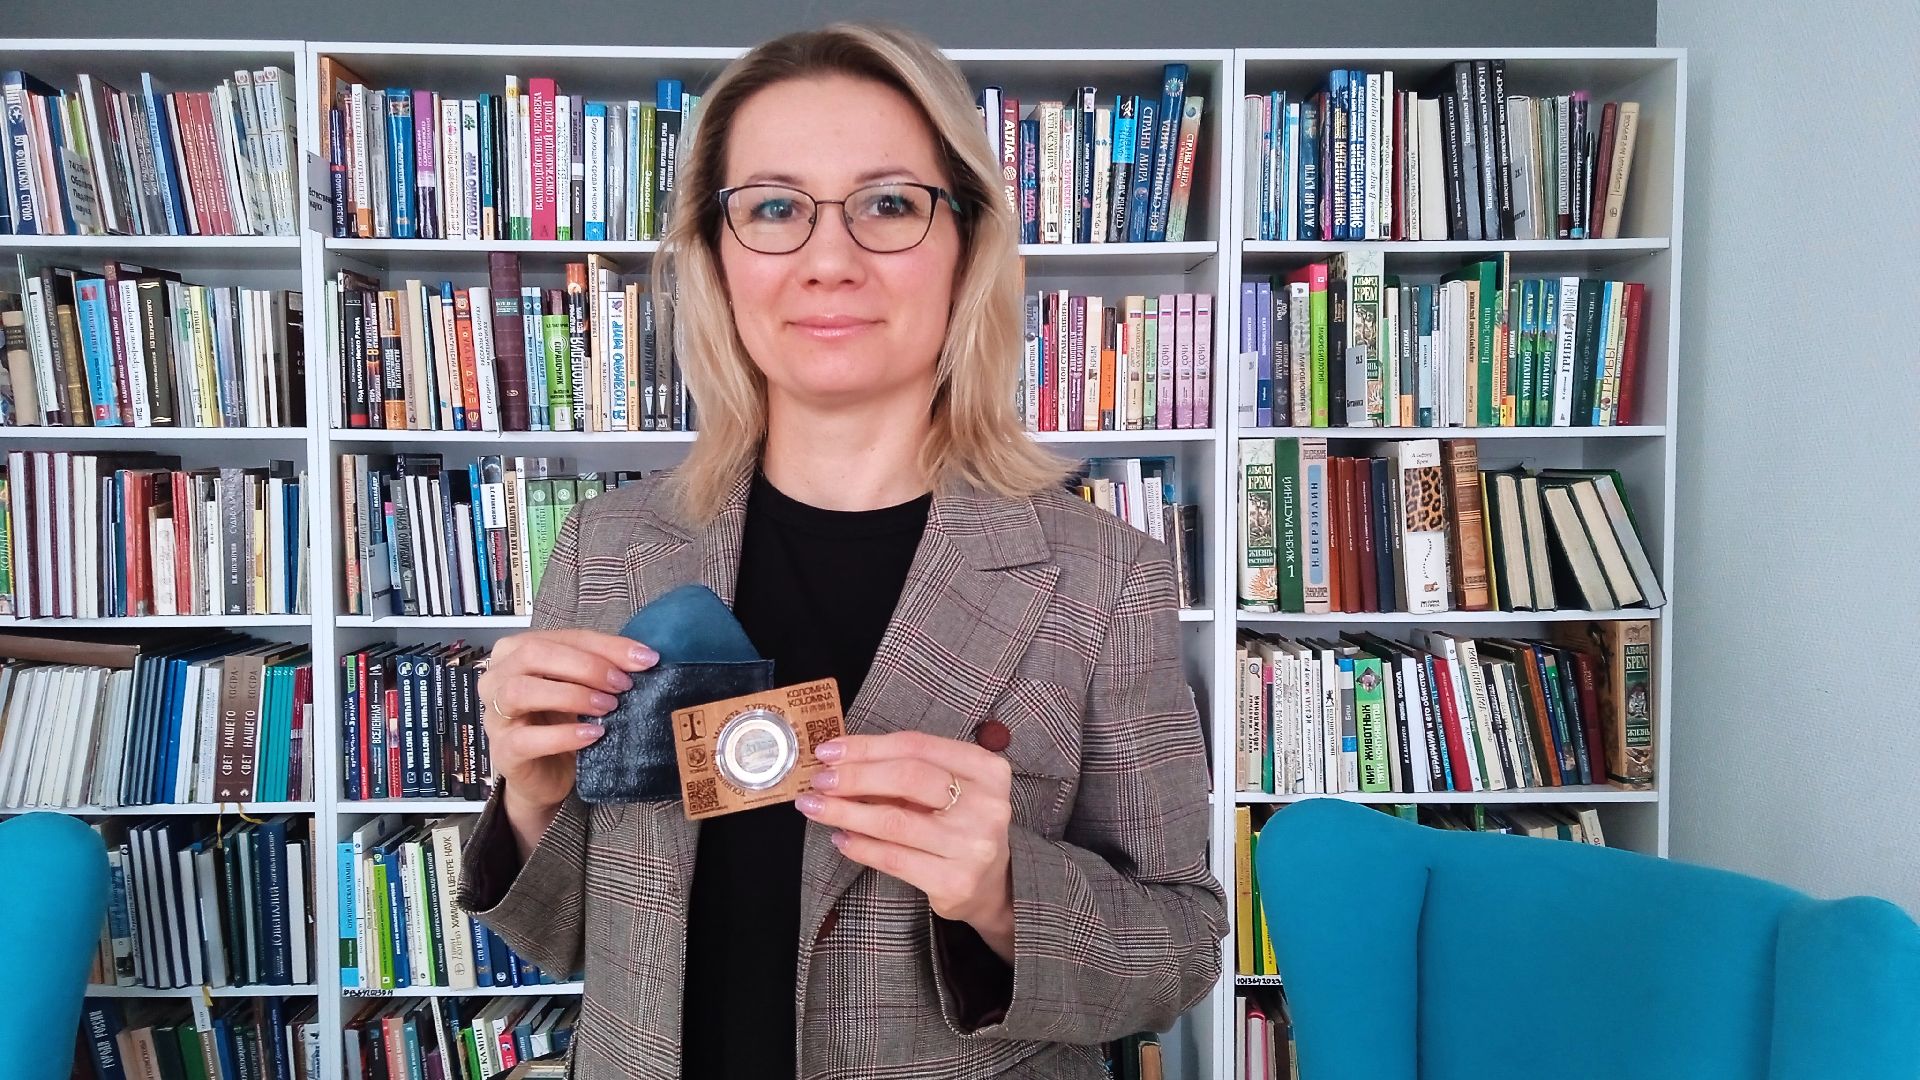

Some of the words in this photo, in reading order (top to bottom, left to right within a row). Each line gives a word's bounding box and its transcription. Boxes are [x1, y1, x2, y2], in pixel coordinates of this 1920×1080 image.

[533, 92, 543, 135] ЧЕЛОВЕКА
[543, 100, 553, 133] СРЕДОЙ
[1140, 107, 1151, 149] СТРАНЫ
[1004, 120, 1015, 162] АТЛАС
[533, 135, 544, 211] ВЗАИМОДЕЙСТВИЕ
[543, 135, 554, 195] ОКРУЖАЮЩЕЙ
[1138, 153, 1149, 183] МИРА
[611, 320, 624, 350] МИР
[1562, 331, 1573, 373] ГРИБЫ
[554, 341, 563, 385] СПРАВОЧНИК
[570, 337, 585, 420] ЭНЦИКЛОПЕДИЯ
[612, 353, 625, 407] ПОЗНАЮ
[1523, 351, 1533, 397] БОТАНИКА
[1541, 351, 1551, 397] БОТАНИКА
[612, 409, 626, 420] Я
[1248, 475, 1272, 490] БРЕМ
[1282, 476, 1294, 528] РАСТЕНИЙ
[1311, 482, 1319, 554] ВЕРЗИЛИН
[1286, 529, 1294, 562] ЖИЗНЬ
[1626, 657, 1649, 670] БРЕМ
[403, 679, 413, 728] СОЛНЕЧНАЯ
[419, 679, 429, 728] СОЛНЕЧНАЯ
[786, 683, 833, 699] КОЛОМНА
[787, 692, 834, 708] KOLOMNA
[224, 710, 237, 748] НАШЕГО
[242, 710, 256, 748] НАШЕГО
[371, 704, 381, 744] ВСЕЛЕННАЯ
[1362, 704, 1373, 761] ЖИВОТНЫХ
[1373, 704, 1384, 760] КОНТИНЕНТОВ
[222, 754, 234, 776] СВЕТ
[240, 754, 252, 776] СВЕТ
[405, 731, 415, 769] СИСТЕМА
[421, 731, 431, 769] СИСТЕМА
[1366, 764, 1375, 785] МИР
[1377, 763, 1386, 785] ПЯТИ
[442, 836, 453, 857] НАУК
[446, 859, 456, 888] ЦЕНТРЕ
